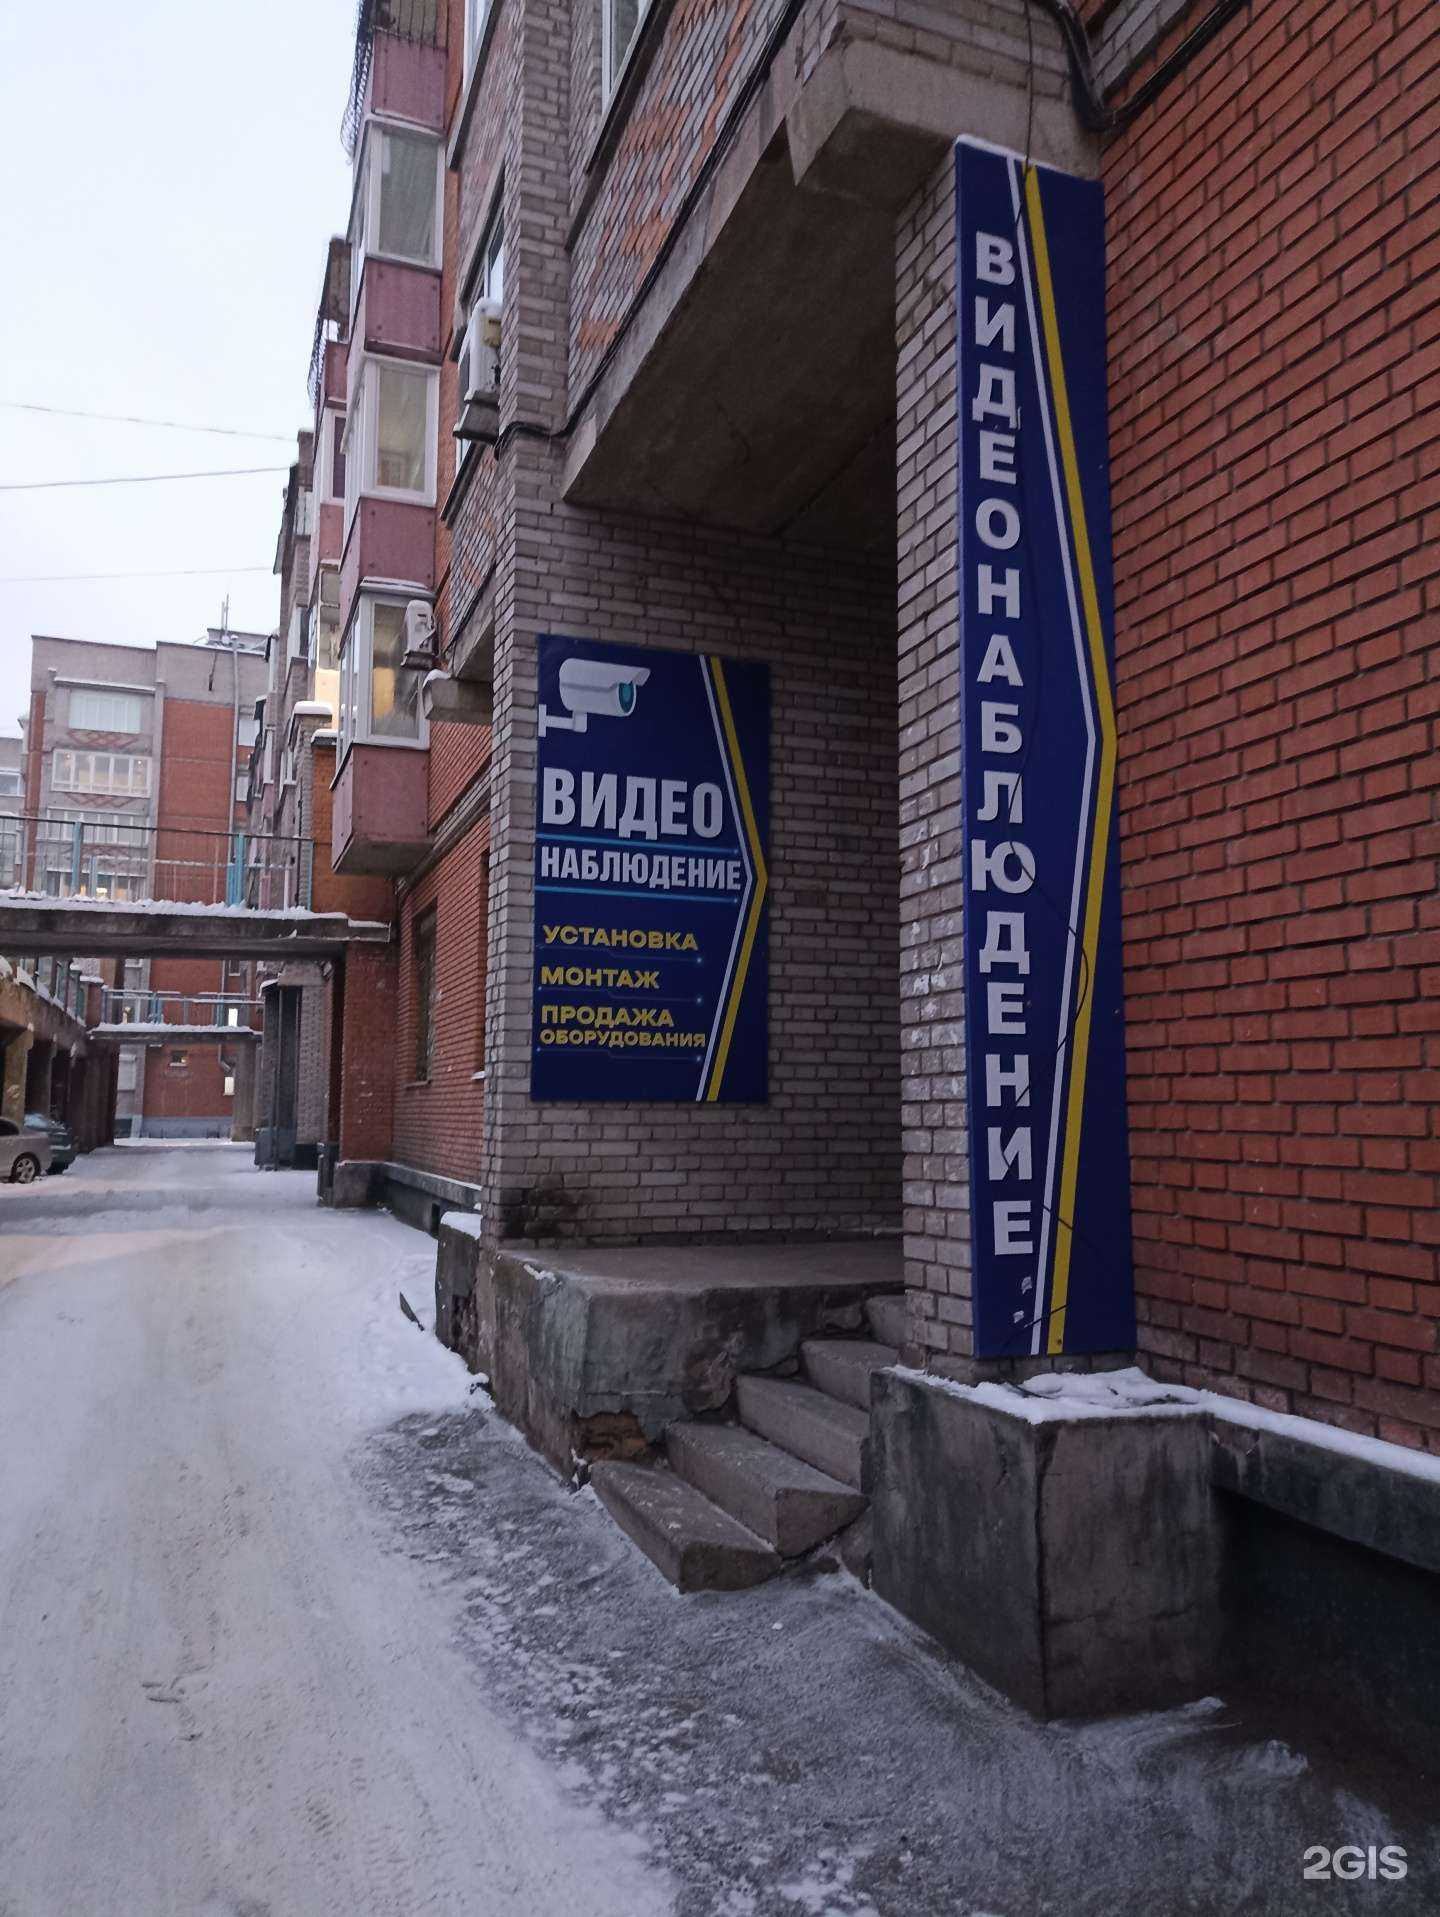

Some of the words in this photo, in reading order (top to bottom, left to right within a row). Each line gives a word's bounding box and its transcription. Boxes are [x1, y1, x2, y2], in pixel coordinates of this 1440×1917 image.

[971, 231, 1036, 1256] ВИДЕОНАБЛЮДЕНИЕ
[542, 766, 724, 841] ВИДЕО
[540, 846, 742, 891] НАБЛЮДЕНИЕ
[542, 924, 699, 951] УСТАНОВКА
[540, 964, 660, 989] МОНТАЖ
[540, 1004, 674, 1028] ПРОДАЖА
[539, 1028, 706, 1049] ОБОРУДОВАНИЯ
